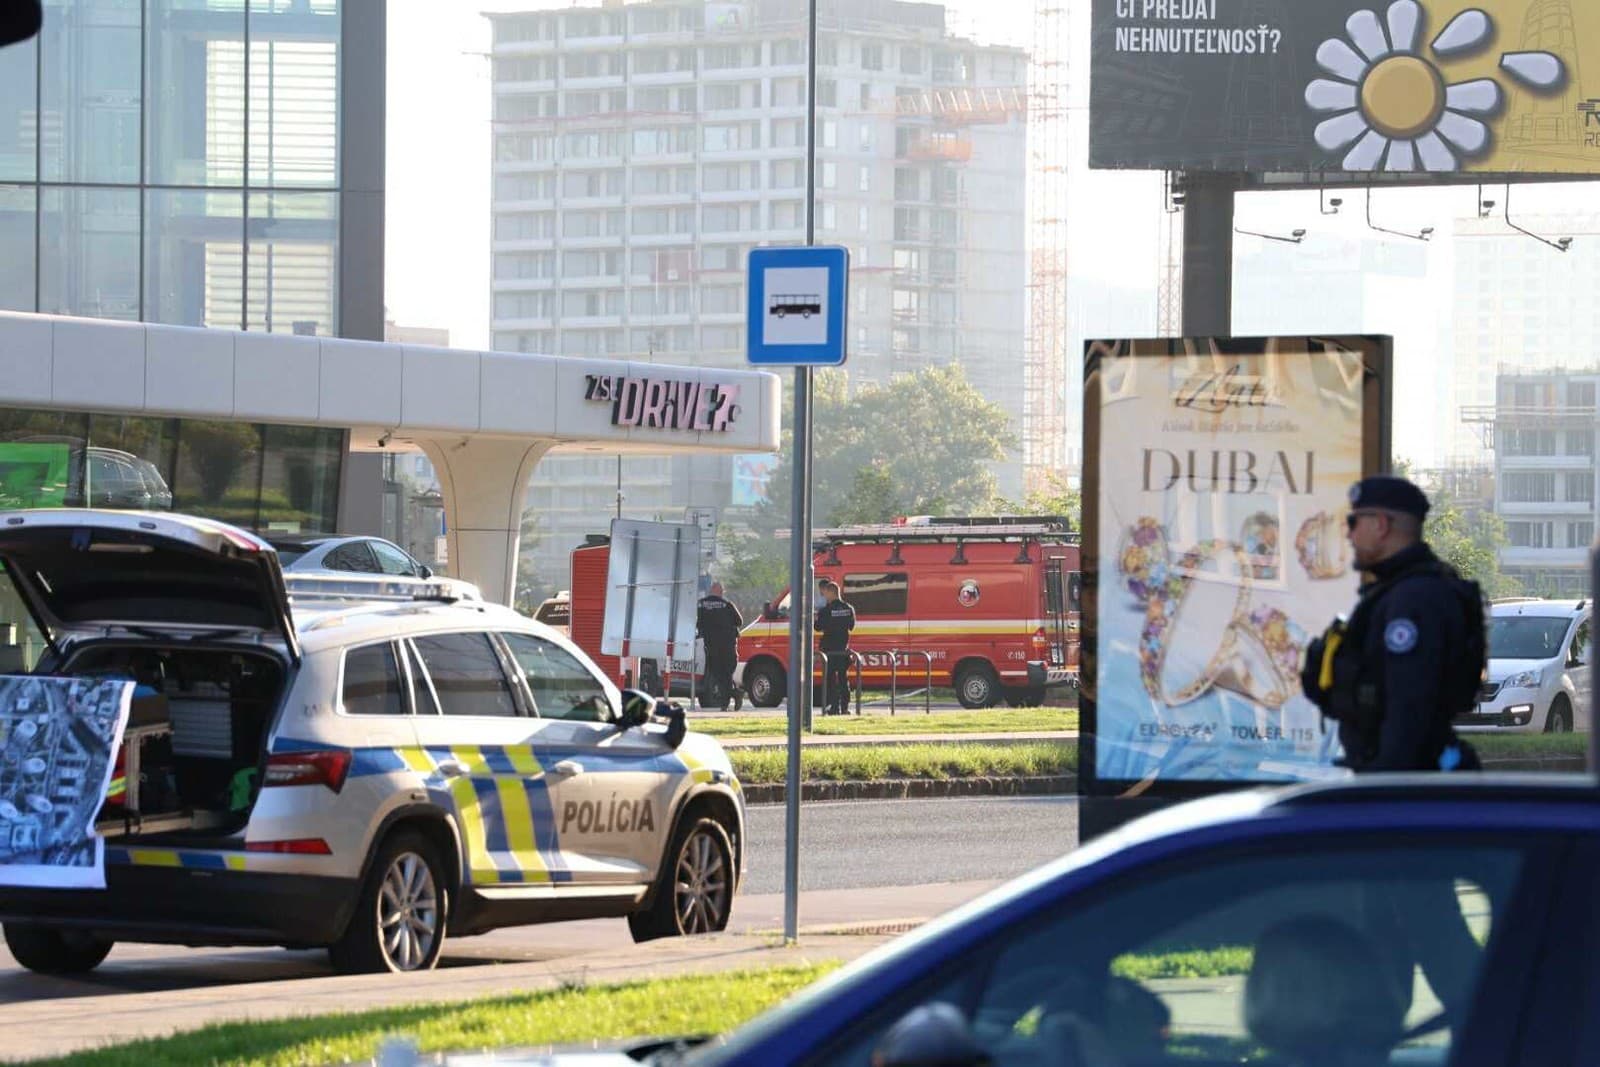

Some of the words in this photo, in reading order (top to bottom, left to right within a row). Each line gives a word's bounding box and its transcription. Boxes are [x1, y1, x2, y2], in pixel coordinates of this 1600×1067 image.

[1115, 24, 1282, 54] NEHNUTEĽNOSŤ?
[1141, 448, 1314, 494] DUBAI
[850, 648, 910, 667] ASIČI
[560, 791, 655, 834] POLÍCIA
